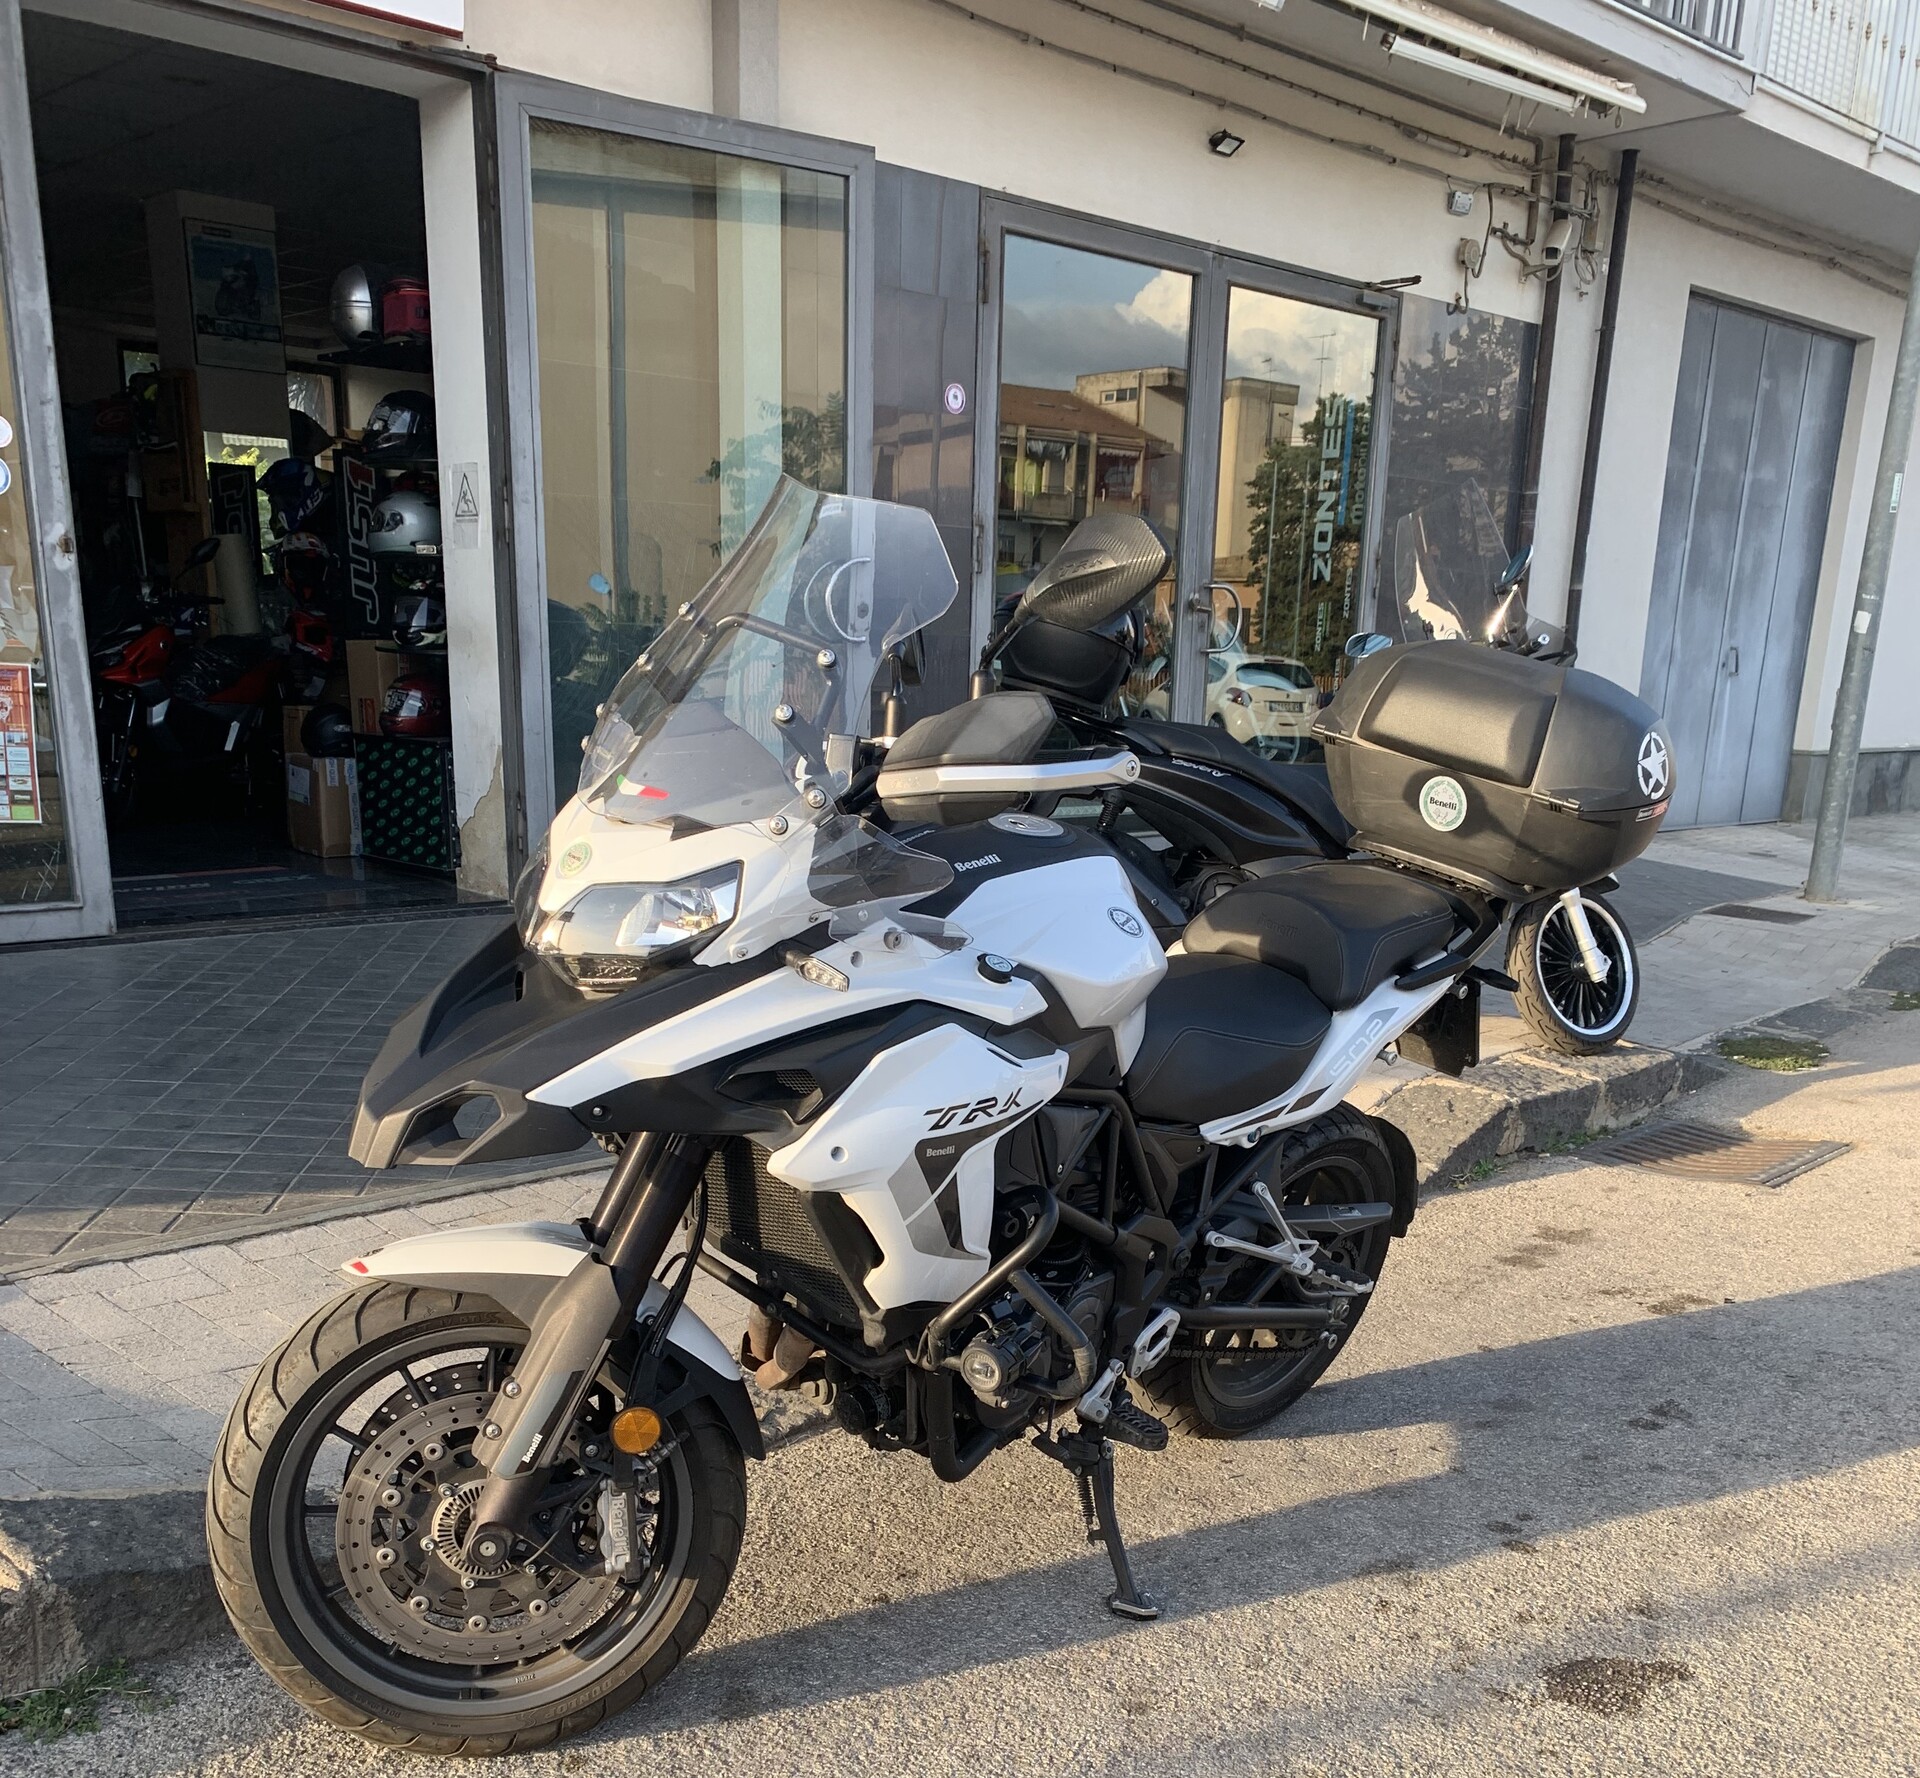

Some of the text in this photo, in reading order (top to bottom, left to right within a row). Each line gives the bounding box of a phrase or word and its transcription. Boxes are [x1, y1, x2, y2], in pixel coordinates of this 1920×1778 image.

[1312, 396, 1345, 582] ZONTES
[1343, 567, 1353, 619] ZONTES
[1315, 602, 1325, 652] ZONTES
[1429, 796, 1457, 811] Benelli
[954, 853, 1002, 873] Benelli
[923, 1087, 1023, 1131] TRK
[926, 1145, 956, 1158] Benelli
[522, 1433, 544, 1464] Benelli
[610, 1499, 630, 1553] Benelli
[545, 1677, 614, 1719] DUNLOP
